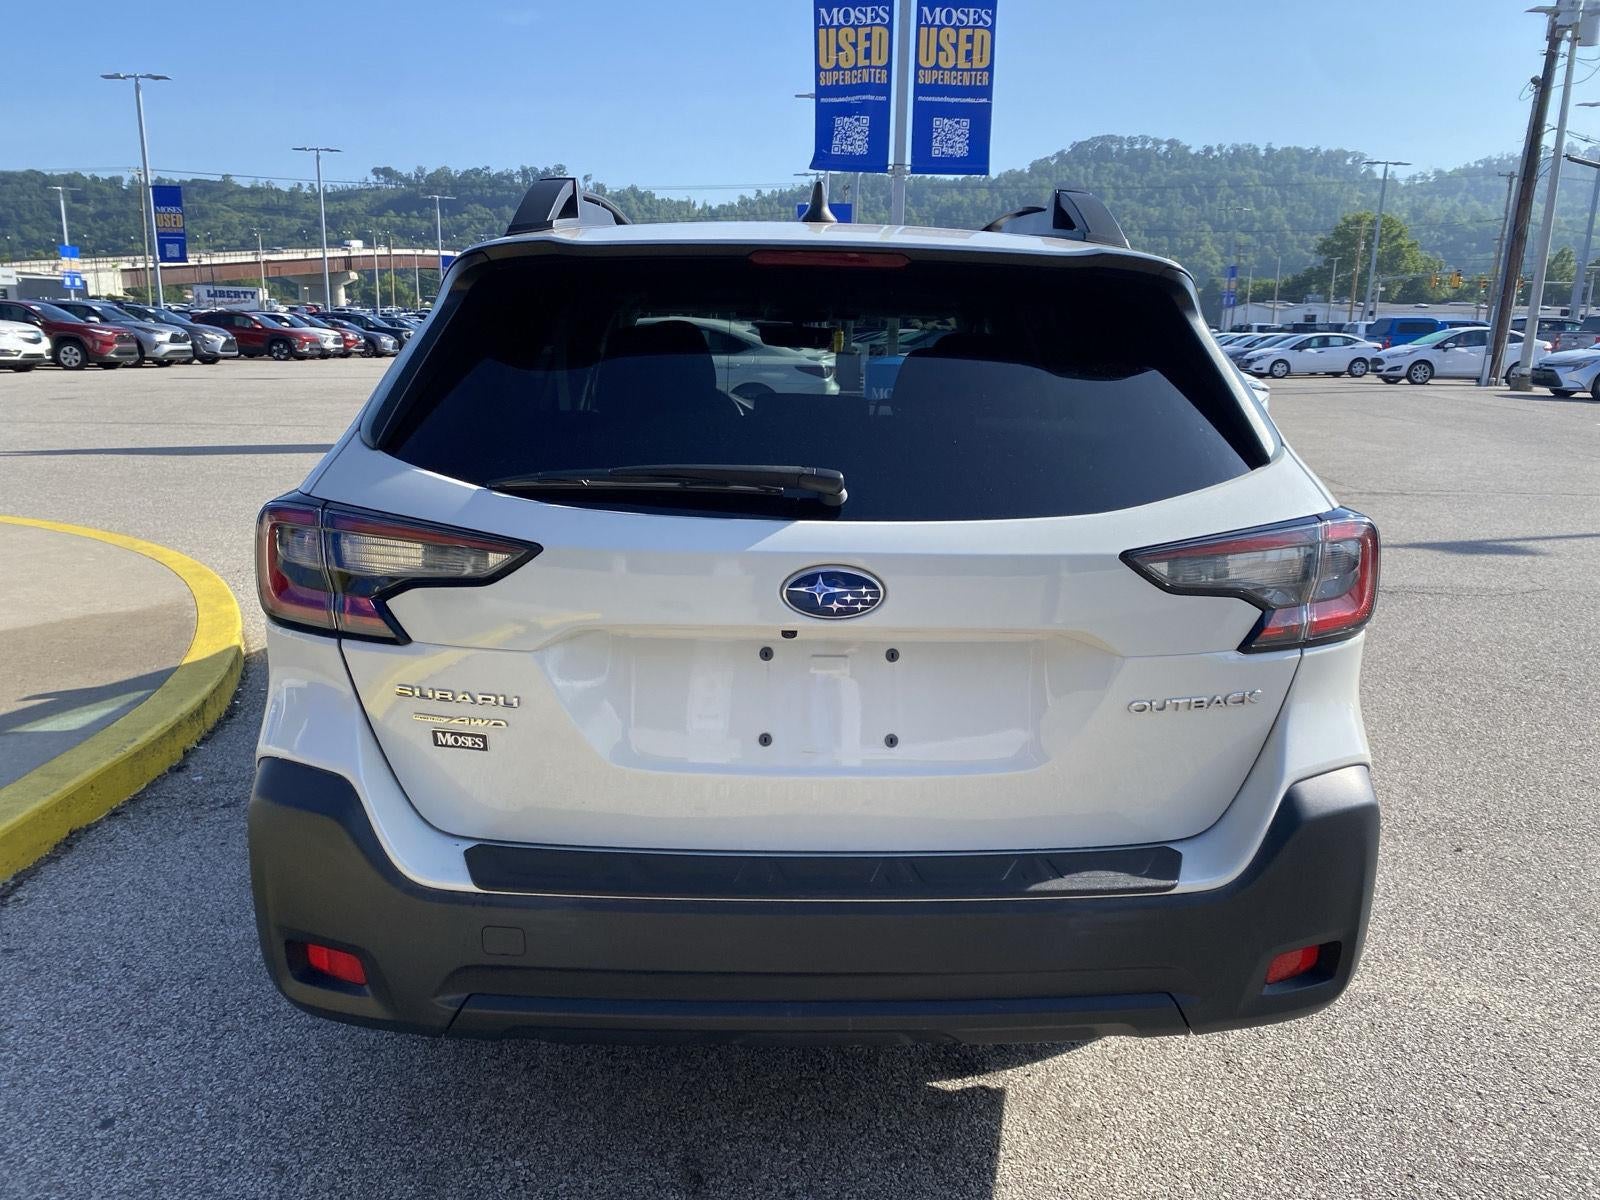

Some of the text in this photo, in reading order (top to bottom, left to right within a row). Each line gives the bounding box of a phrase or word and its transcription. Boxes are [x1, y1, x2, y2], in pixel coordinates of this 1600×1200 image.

[819, 6, 889, 26] MOSES
[921, 6, 992, 27] MOSES
[818, 26, 889, 69] USED
[918, 27, 991, 69] USED
[819, 68, 888, 86] SUPERCENTER
[918, 69, 989, 86] SUPERCENTER
[156, 213, 183, 228] USED
[206, 289, 256, 299] LIBERTY
[395, 684, 520, 708] SUBARU
[1127, 688, 1263, 714] OUTBACK
[448, 716, 508, 729] AWD
[436, 731, 484, 749] MOSES
